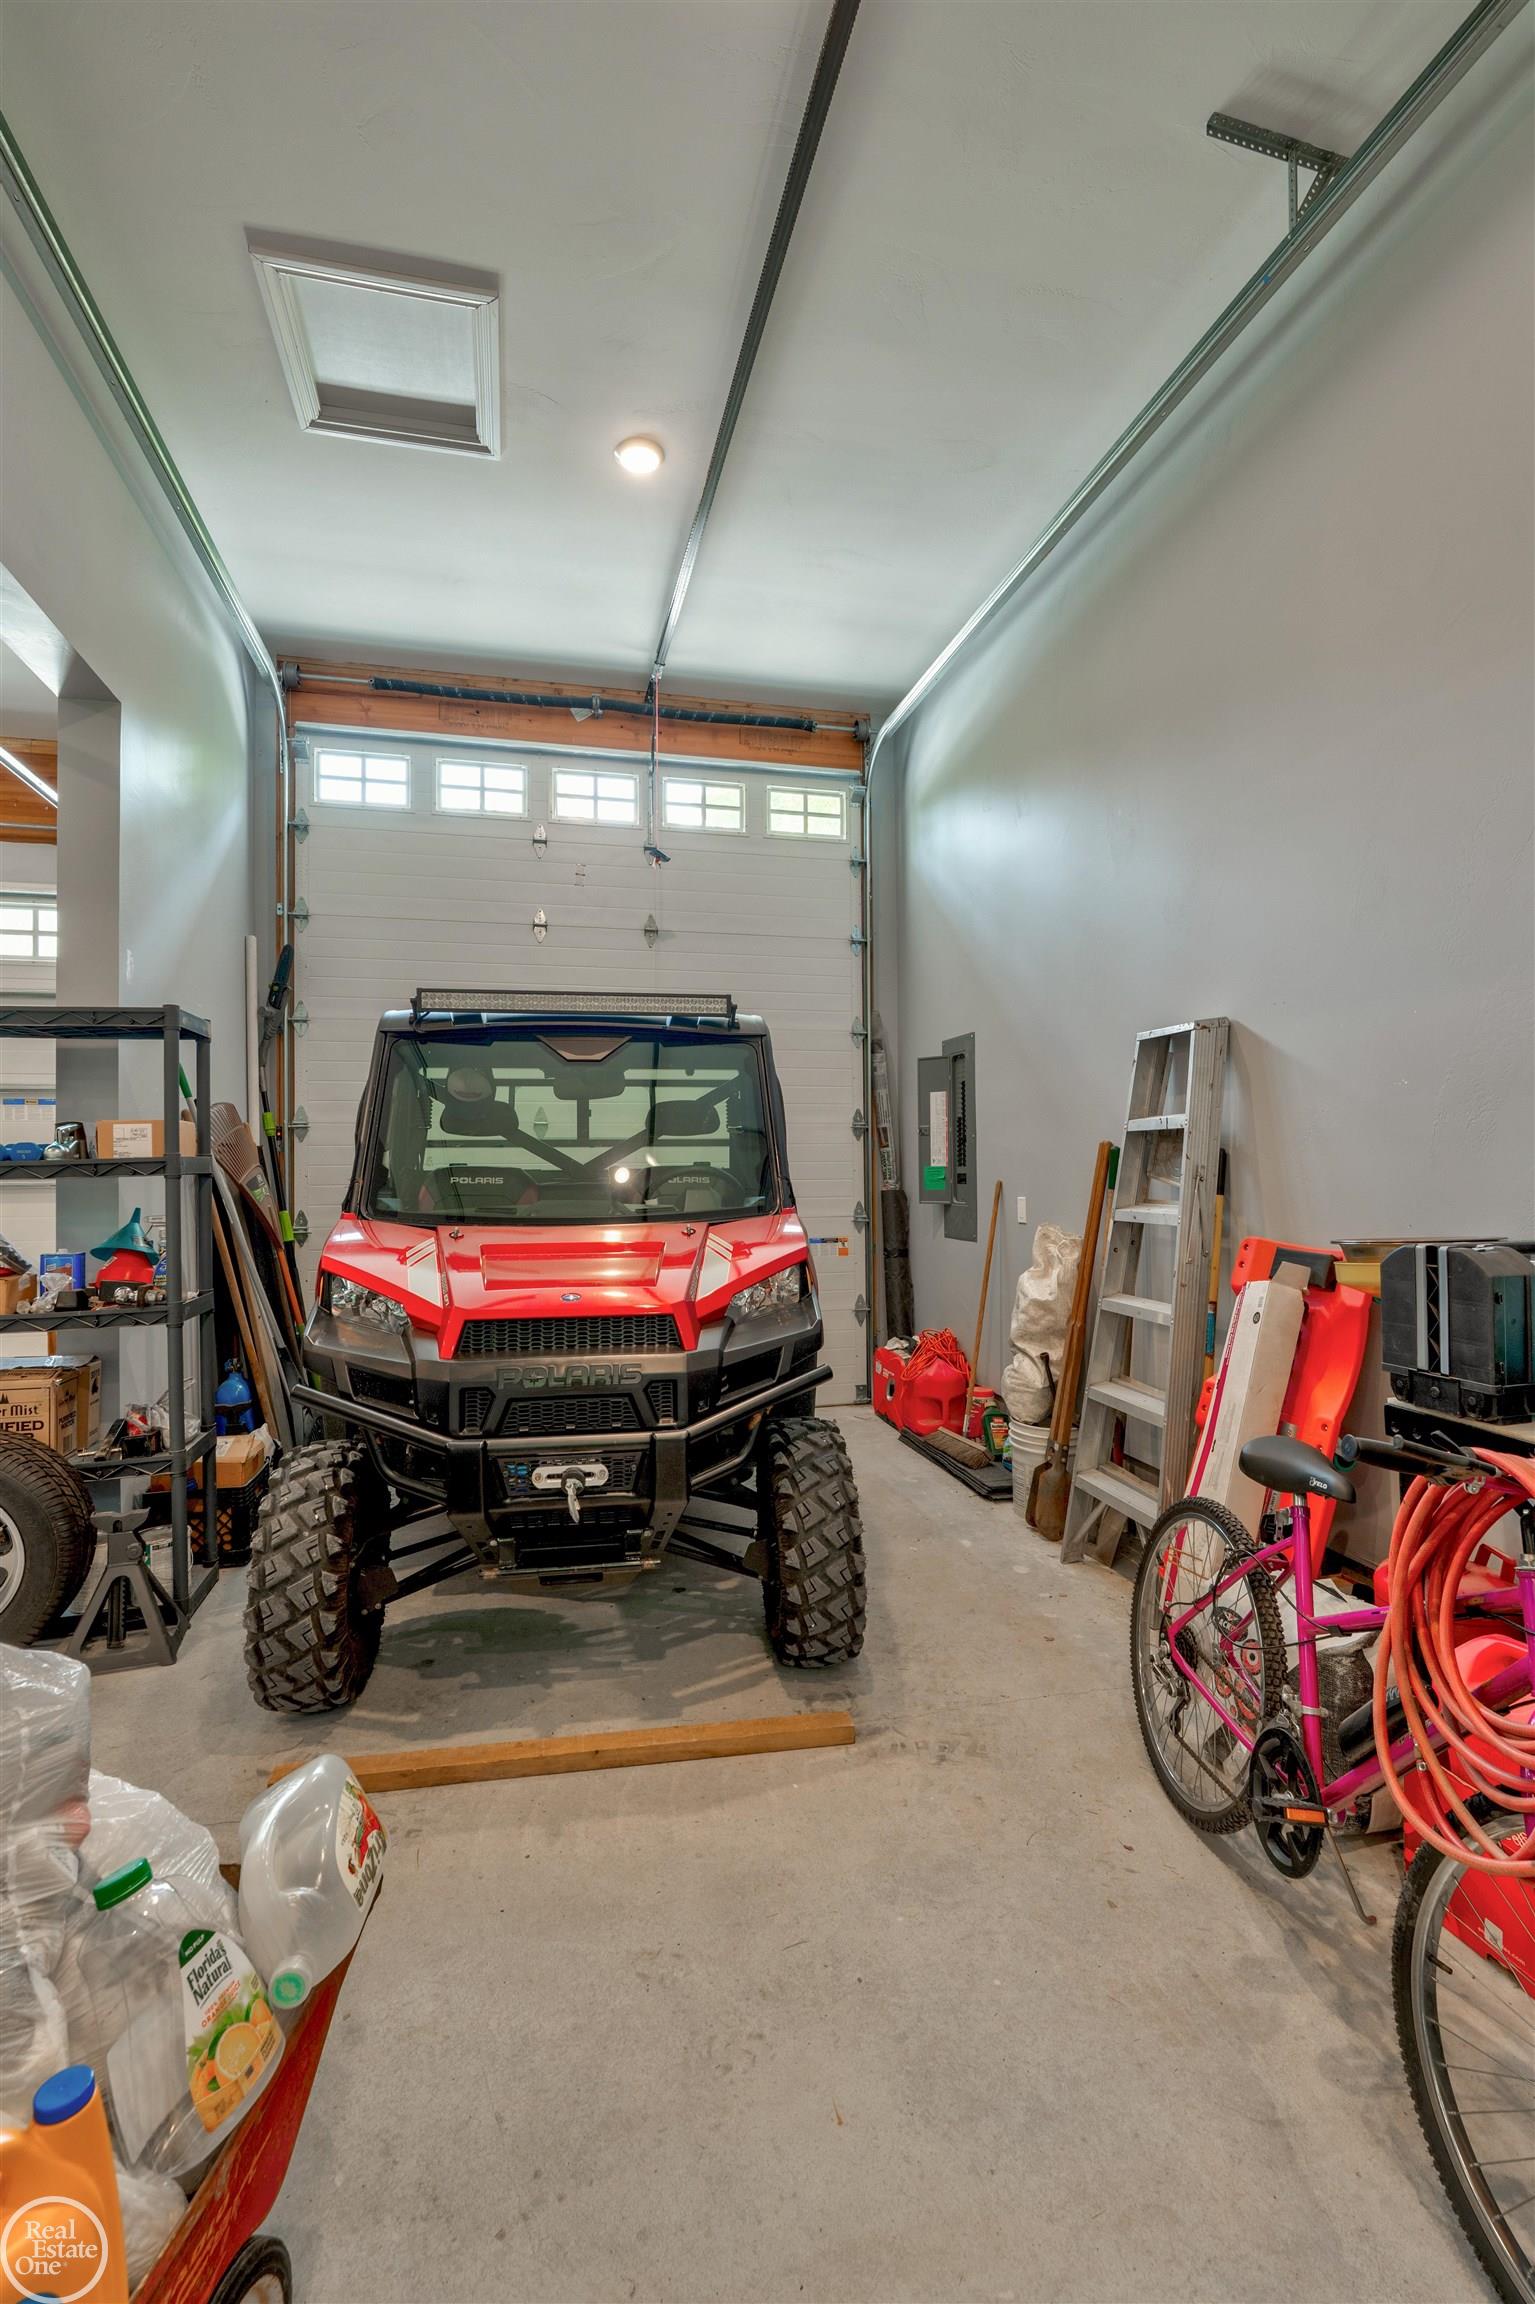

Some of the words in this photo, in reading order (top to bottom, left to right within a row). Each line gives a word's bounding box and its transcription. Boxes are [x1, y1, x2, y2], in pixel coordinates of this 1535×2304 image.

[450, 1176, 504, 1185] POLARIS
[496, 1363, 642, 1390] POLARIS
[10, 1404, 40, 1417] Mist
[193, 1956, 232, 2007] Natural
